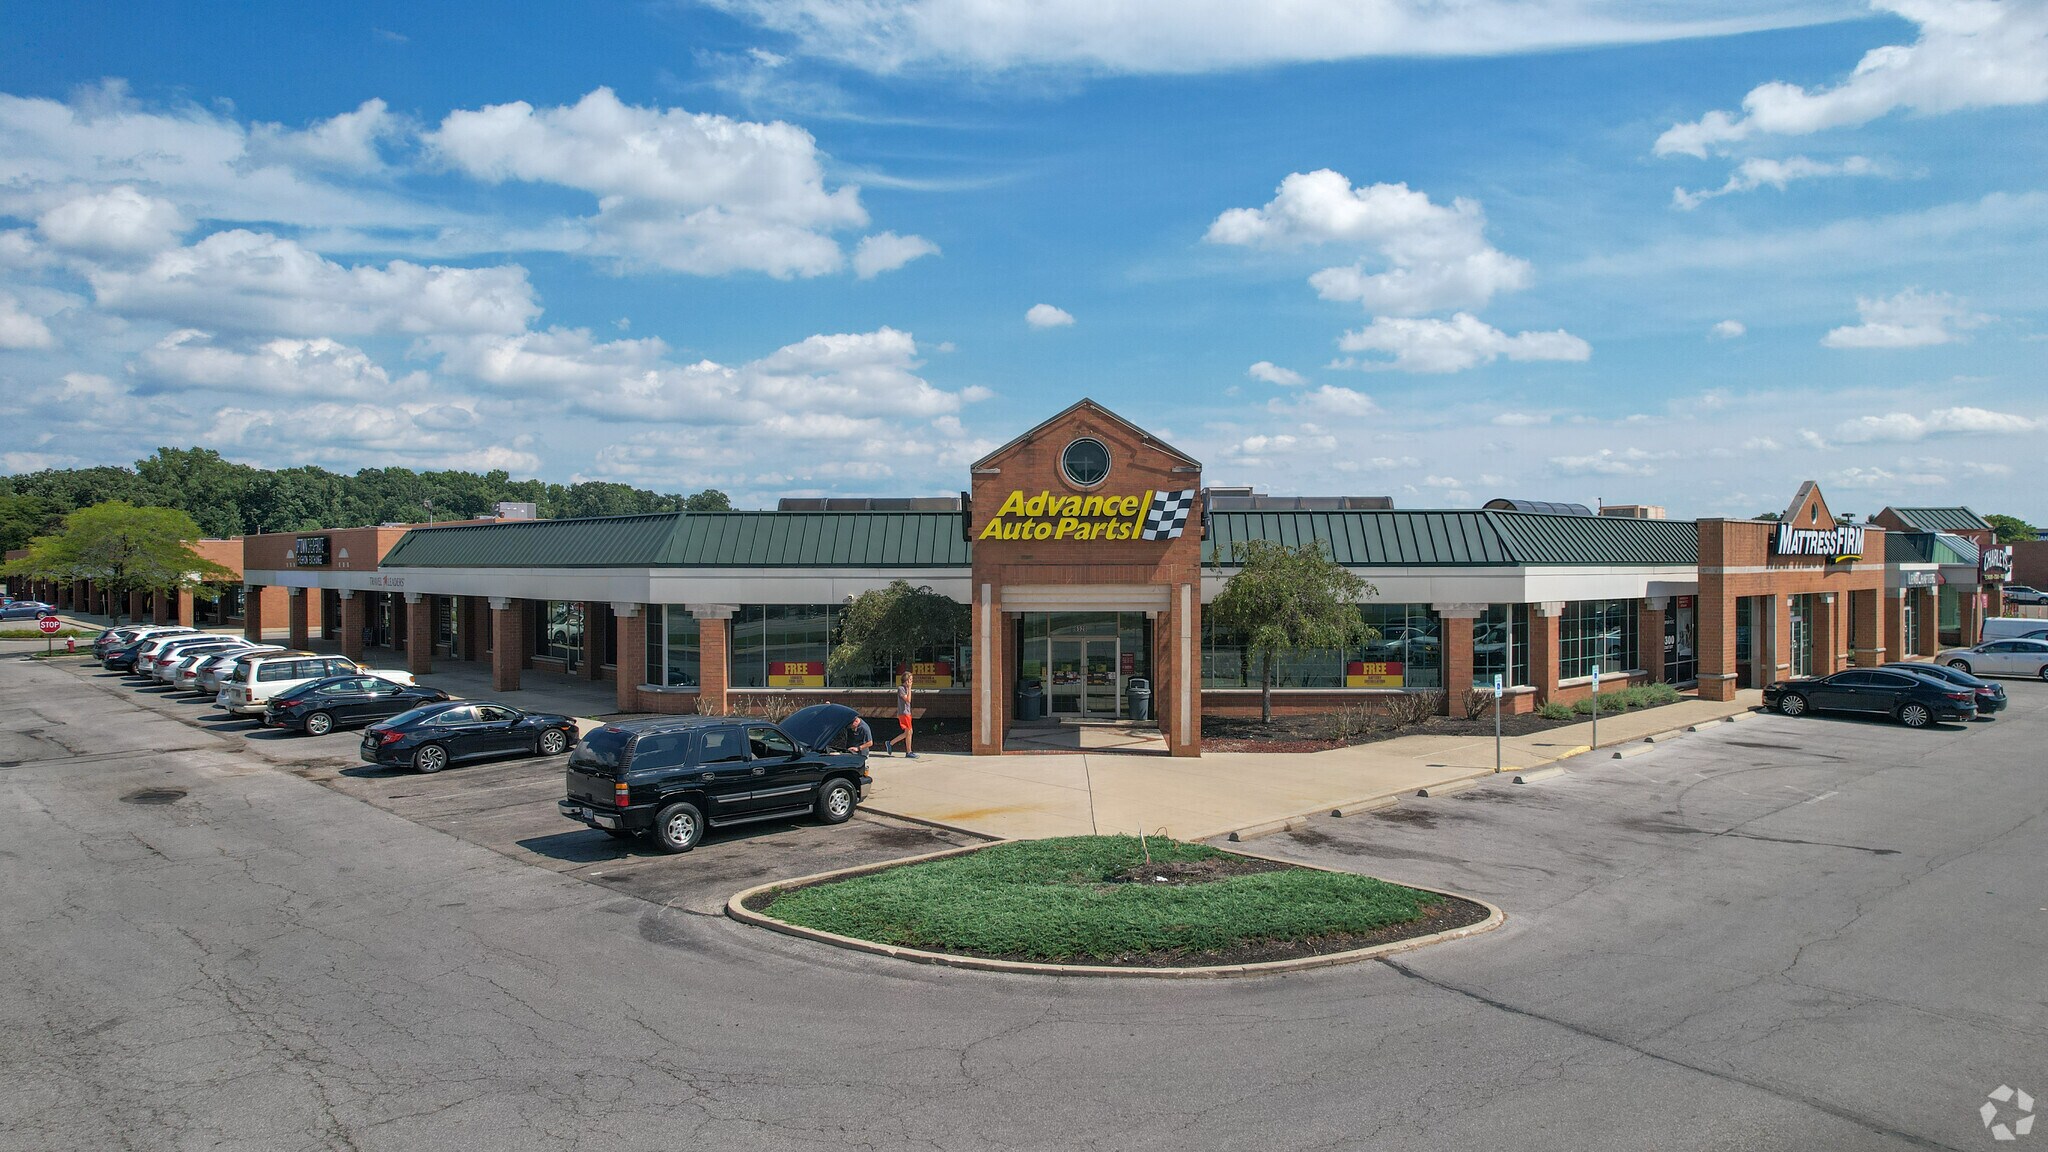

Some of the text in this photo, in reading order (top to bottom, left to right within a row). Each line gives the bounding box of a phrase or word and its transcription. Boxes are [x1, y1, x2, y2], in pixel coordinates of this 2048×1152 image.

[996, 490, 1139, 517] Advance
[978, 518, 1133, 540] Auto Parts
[40, 621, 60, 629] STOP
[784, 662, 808, 675] FREE
[911, 663, 936, 675] FREE
[1363, 662, 1387, 675] FREE
